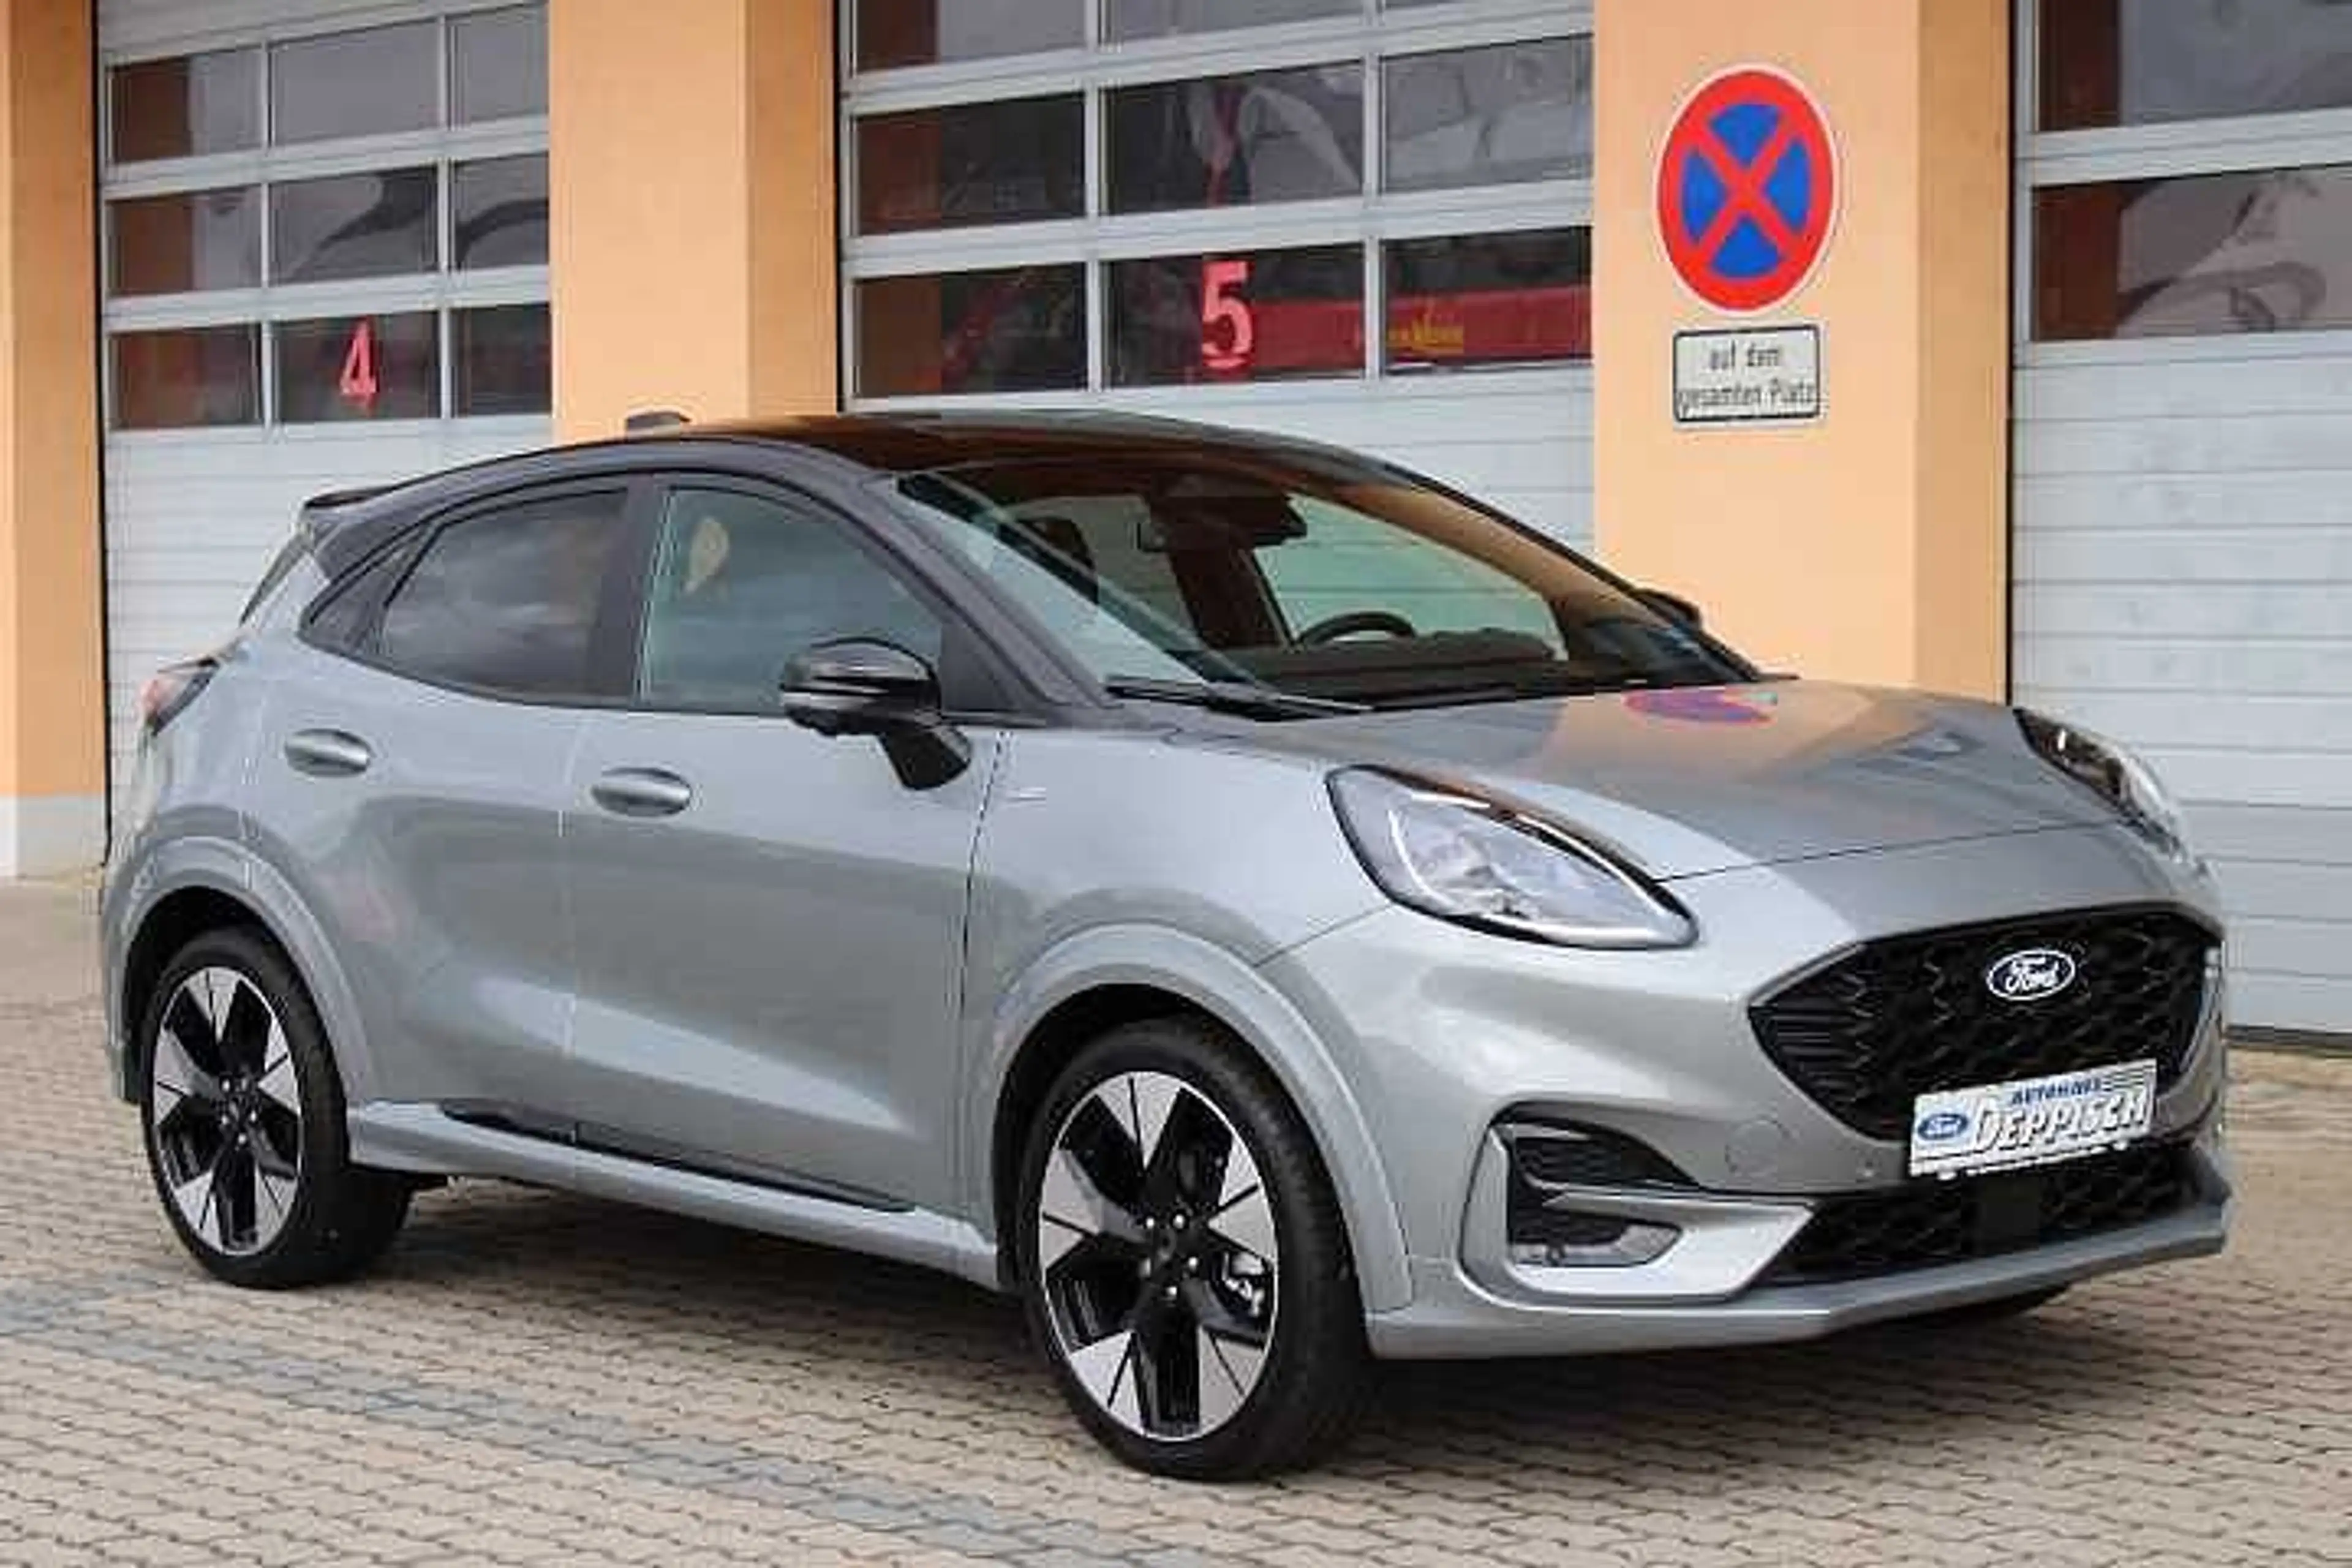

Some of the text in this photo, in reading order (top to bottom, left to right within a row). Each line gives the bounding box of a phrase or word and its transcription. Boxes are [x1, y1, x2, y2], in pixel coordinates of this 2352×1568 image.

[1202, 260, 1253, 369] 5
[340, 321, 376, 409] 4
[2003, 955, 2062, 994] Ford
[1972, 1090, 2149, 1152] DEPPISCH
